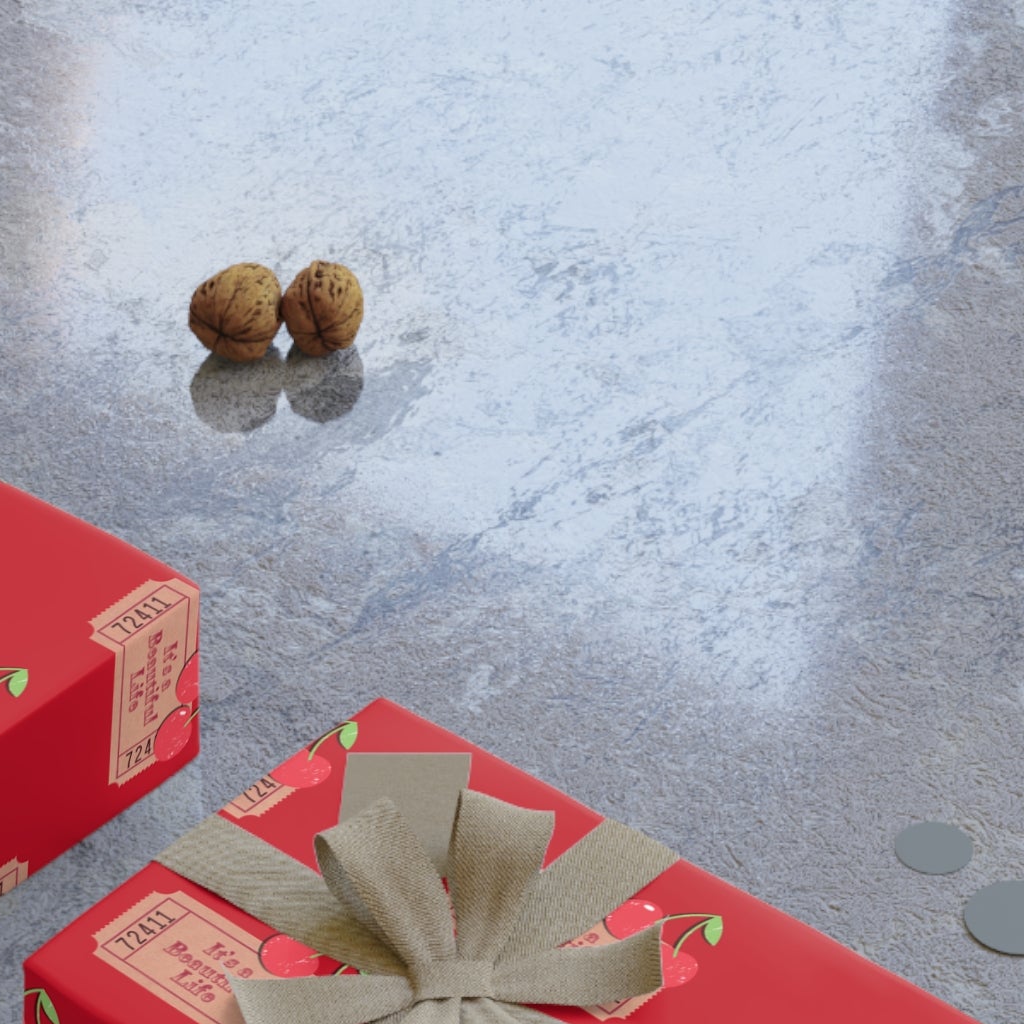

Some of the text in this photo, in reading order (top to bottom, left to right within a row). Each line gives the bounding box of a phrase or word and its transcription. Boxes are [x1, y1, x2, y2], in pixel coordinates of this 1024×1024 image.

[112, 597, 171, 634] 72411
[162, 641, 178, 676] It's
[129, 667, 145, 713] Life
[144, 629, 164, 727] Beautiful
[126, 738, 151, 768] 724
[114, 910, 176, 951] 72411
[169, 969, 216, 1003] Life
[237, 967, 254, 979] a
